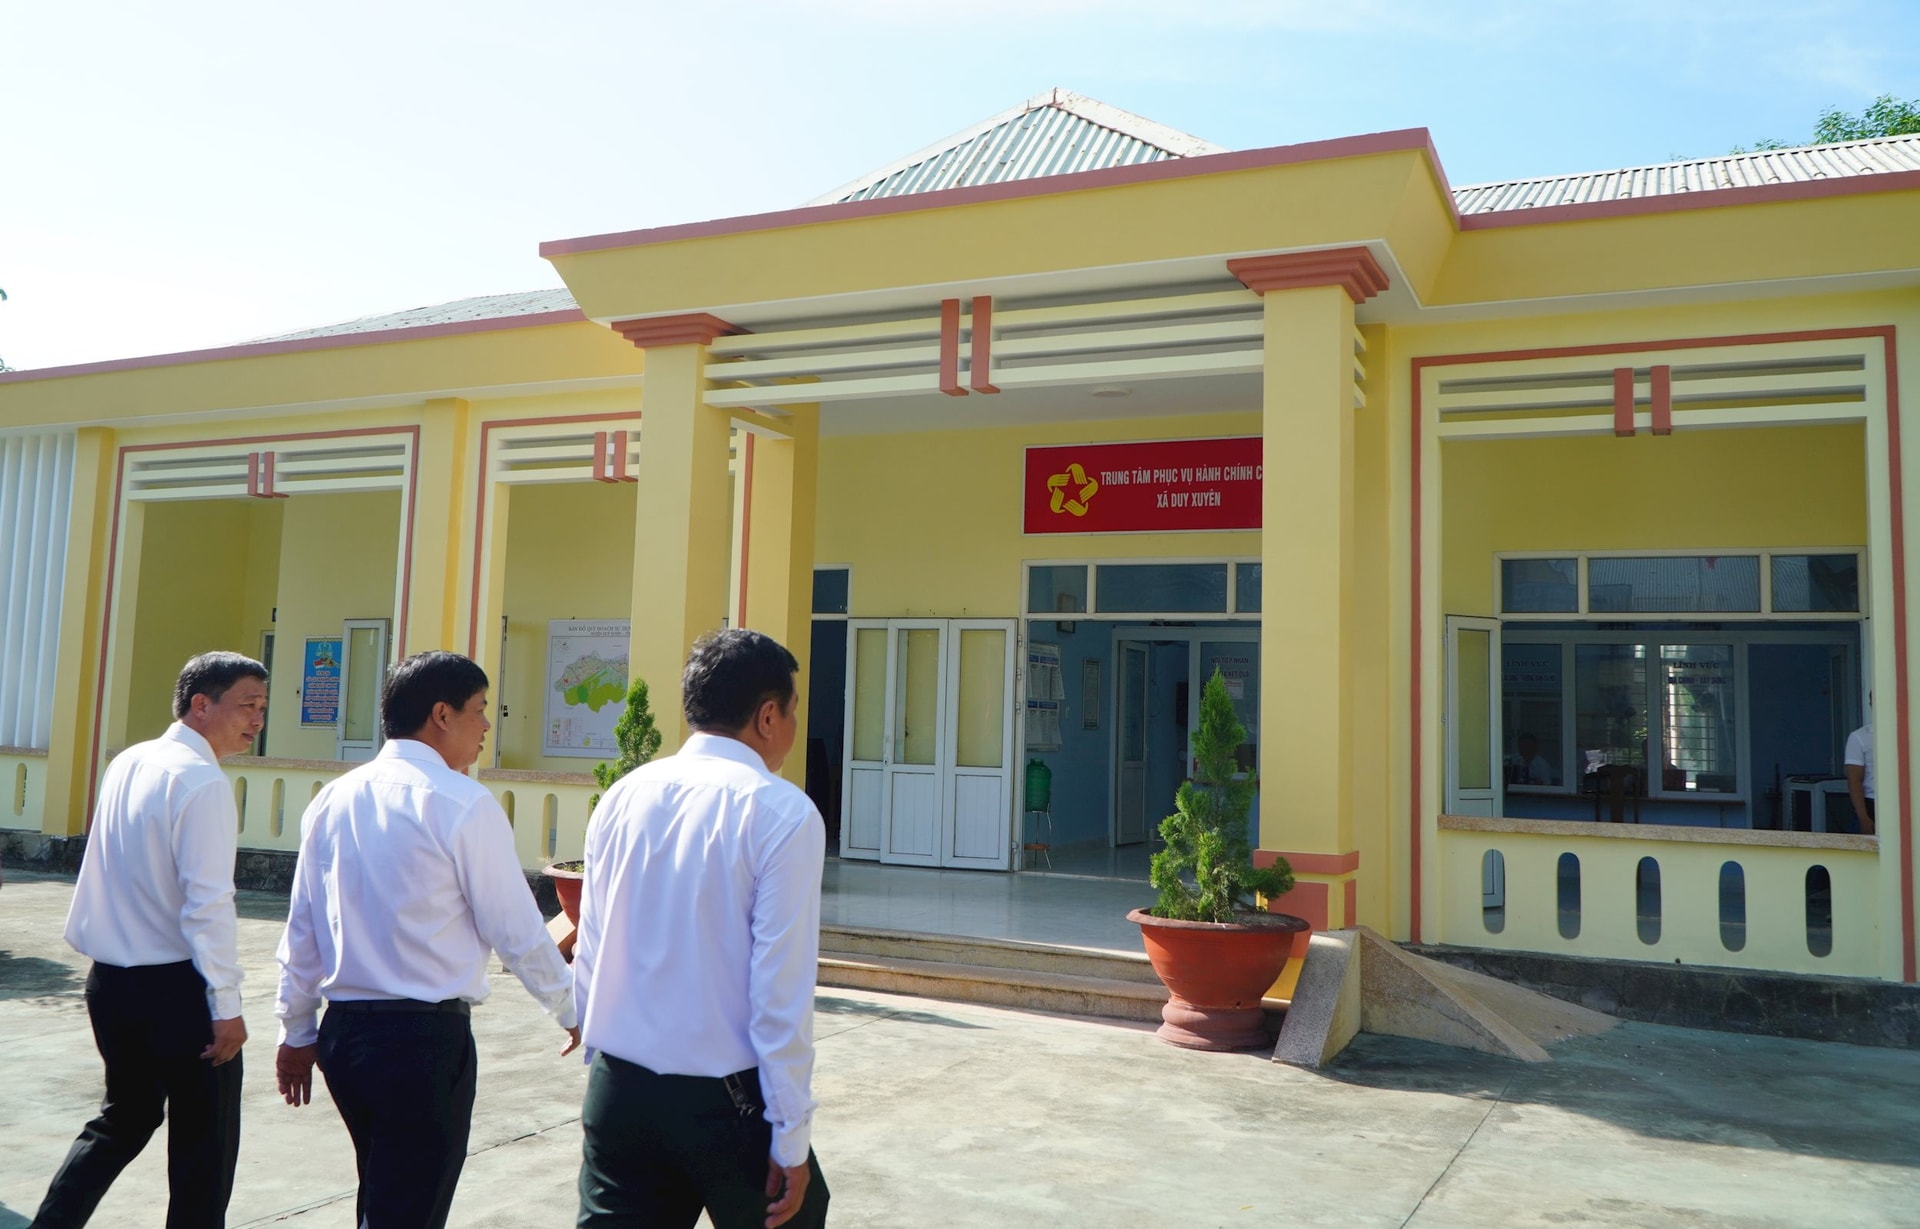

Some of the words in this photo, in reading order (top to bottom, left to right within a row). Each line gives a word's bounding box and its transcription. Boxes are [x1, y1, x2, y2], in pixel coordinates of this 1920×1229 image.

[1100, 470, 1130, 486] TRUNG
[1131, 466, 1151, 484] TÂM
[1153, 468, 1178, 486] PHỤC
[1180, 468, 1193, 486] VỤ
[1195, 463, 1221, 482] HÀNH
[1223, 462, 1253, 481] CHÍNH
[1171, 492, 1189, 508] DUY
[1191, 488, 1221, 507] XUYÊN
